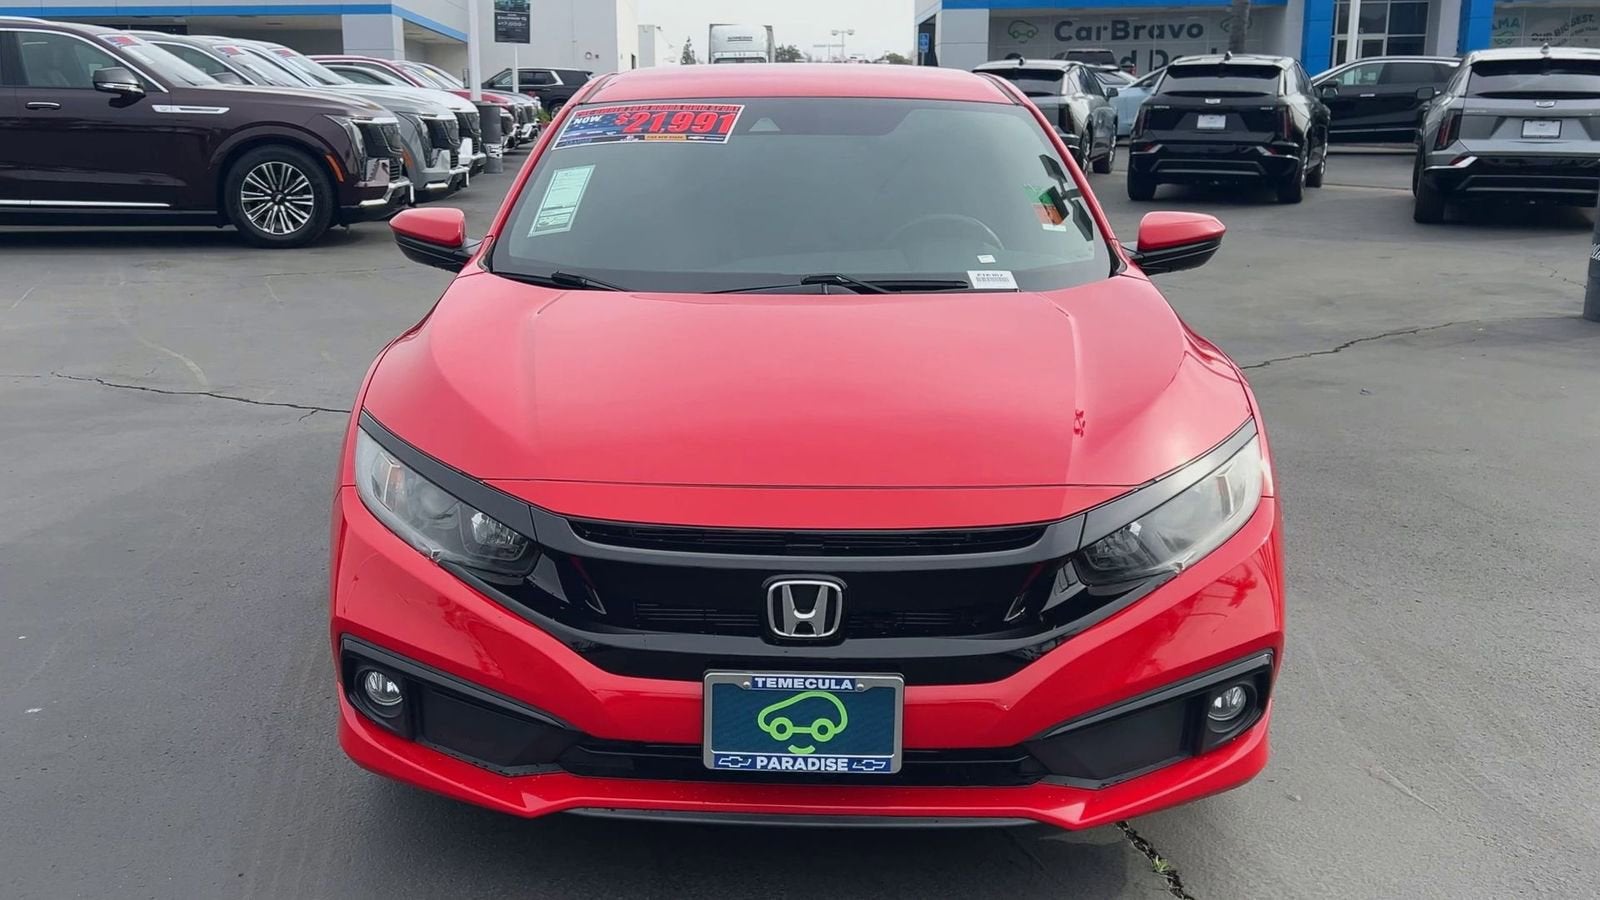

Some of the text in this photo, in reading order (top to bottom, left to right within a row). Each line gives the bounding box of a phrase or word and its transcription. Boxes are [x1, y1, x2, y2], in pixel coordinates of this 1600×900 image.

[1054, 20, 1204, 42] CarBravo
[573, 115, 603, 125] NOW
[614, 111, 736, 133] $21,991
[755, 677, 854, 690] TEMECULA
[756, 756, 849, 771] PARADISE
